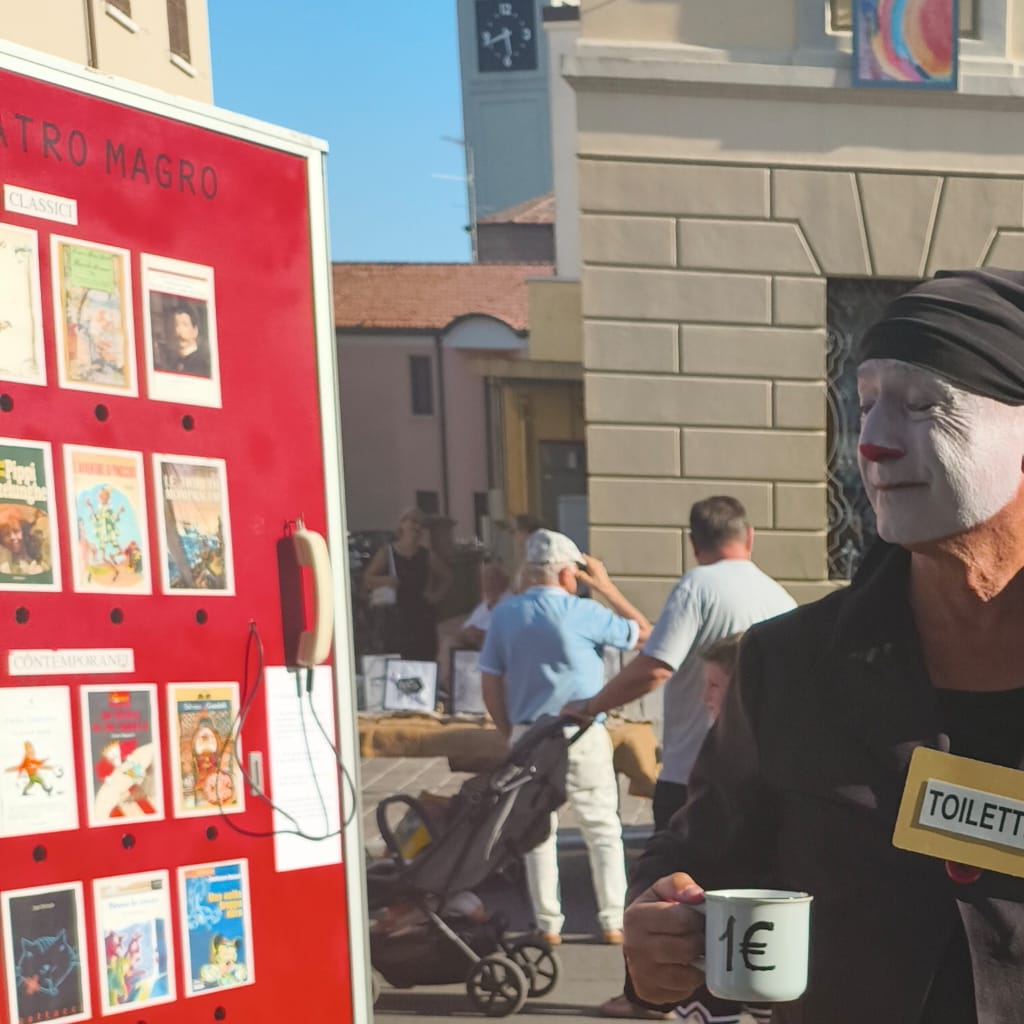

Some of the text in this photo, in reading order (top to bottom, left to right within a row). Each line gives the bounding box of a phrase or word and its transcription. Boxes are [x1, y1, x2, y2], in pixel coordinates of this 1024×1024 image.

[105, 138, 218, 200] MAGRO
[9, 190, 73, 219] CLASSICI
[718, 914, 776, 972] 1€
